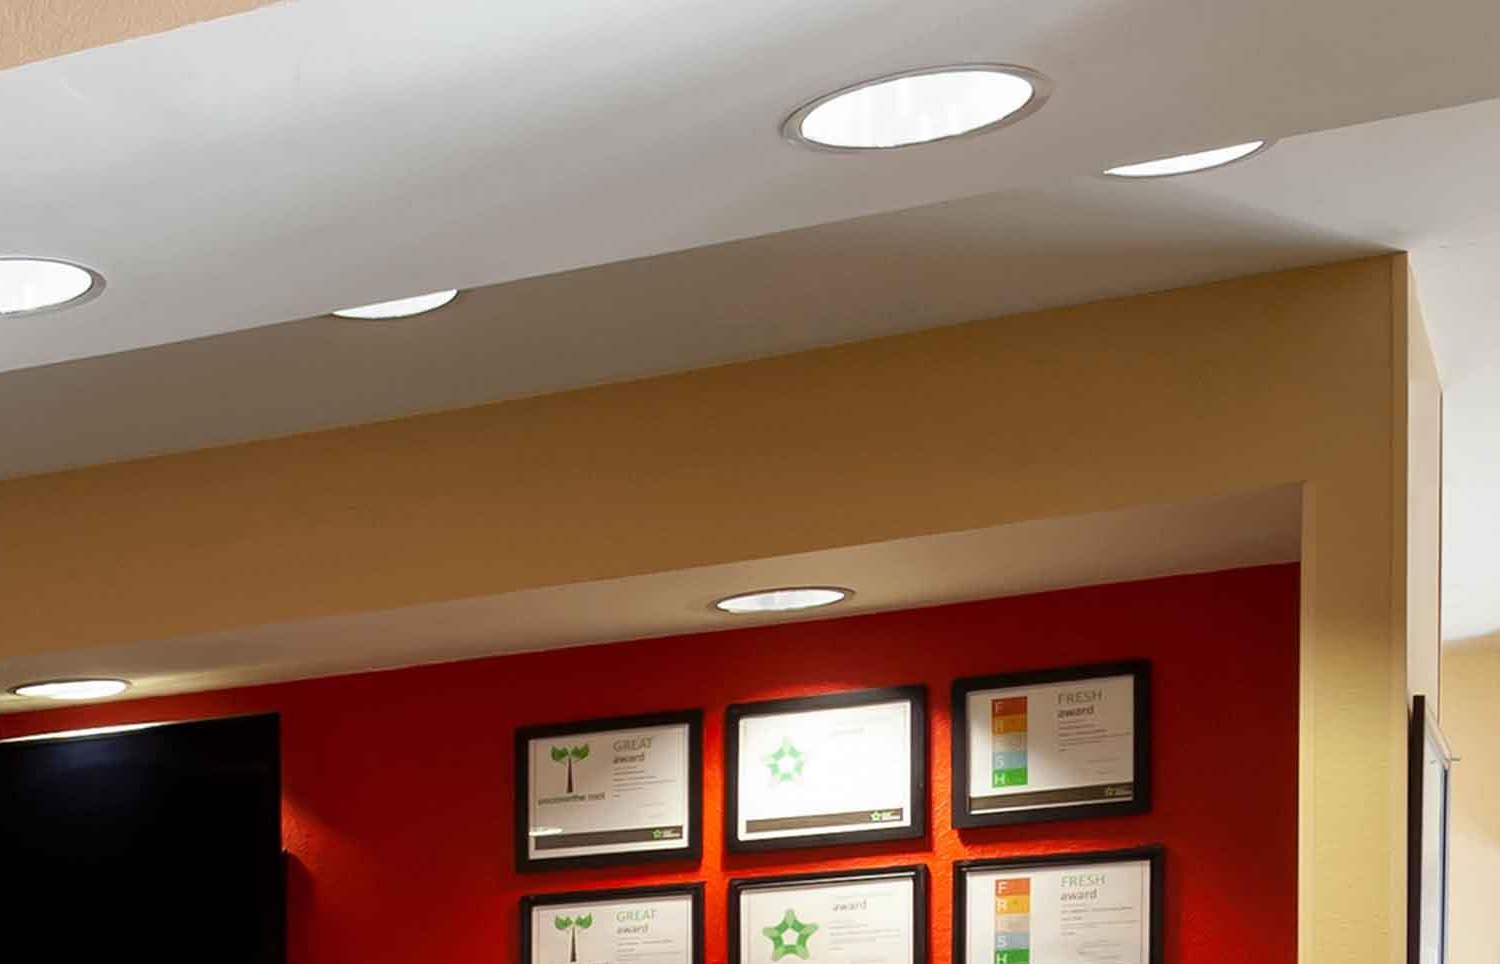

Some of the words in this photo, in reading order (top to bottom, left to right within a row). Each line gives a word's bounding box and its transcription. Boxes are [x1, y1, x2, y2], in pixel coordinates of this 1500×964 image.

[1057, 689, 1103, 705] FRESH
[1057, 705, 1095, 718] award
[613, 738, 653, 752] GREAT
[612, 754, 645, 765] award
[1060, 874, 1106, 888] FRESH
[1060, 888, 1098, 902] award
[831, 899, 868, 912] award
[616, 909, 656, 923] GREAT
[616, 925, 649, 936] award
